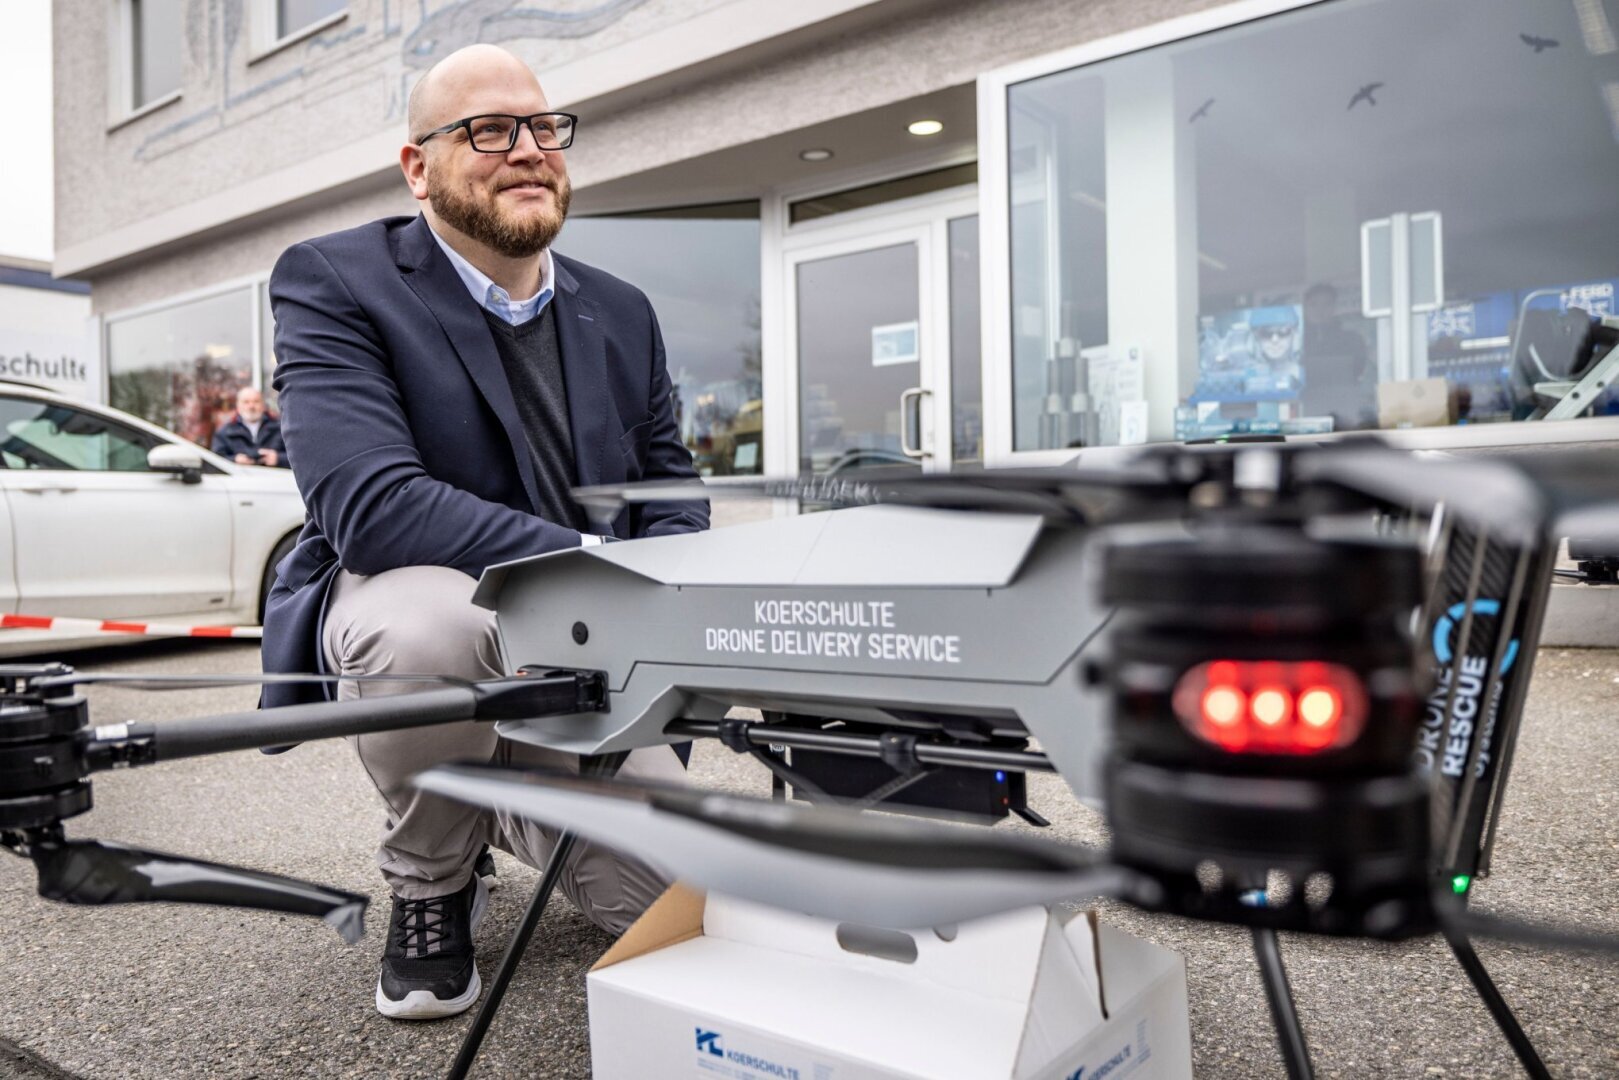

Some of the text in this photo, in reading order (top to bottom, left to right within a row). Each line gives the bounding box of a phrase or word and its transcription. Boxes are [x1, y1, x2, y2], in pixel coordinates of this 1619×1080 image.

[754, 600, 895, 627] KOERSCHULTE
[705, 628, 961, 663] DRONE DELIVERY SERVICE
[1441, 655, 1488, 777] RESCUE
[727, 1049, 799, 1080] KOERSCHULTE
